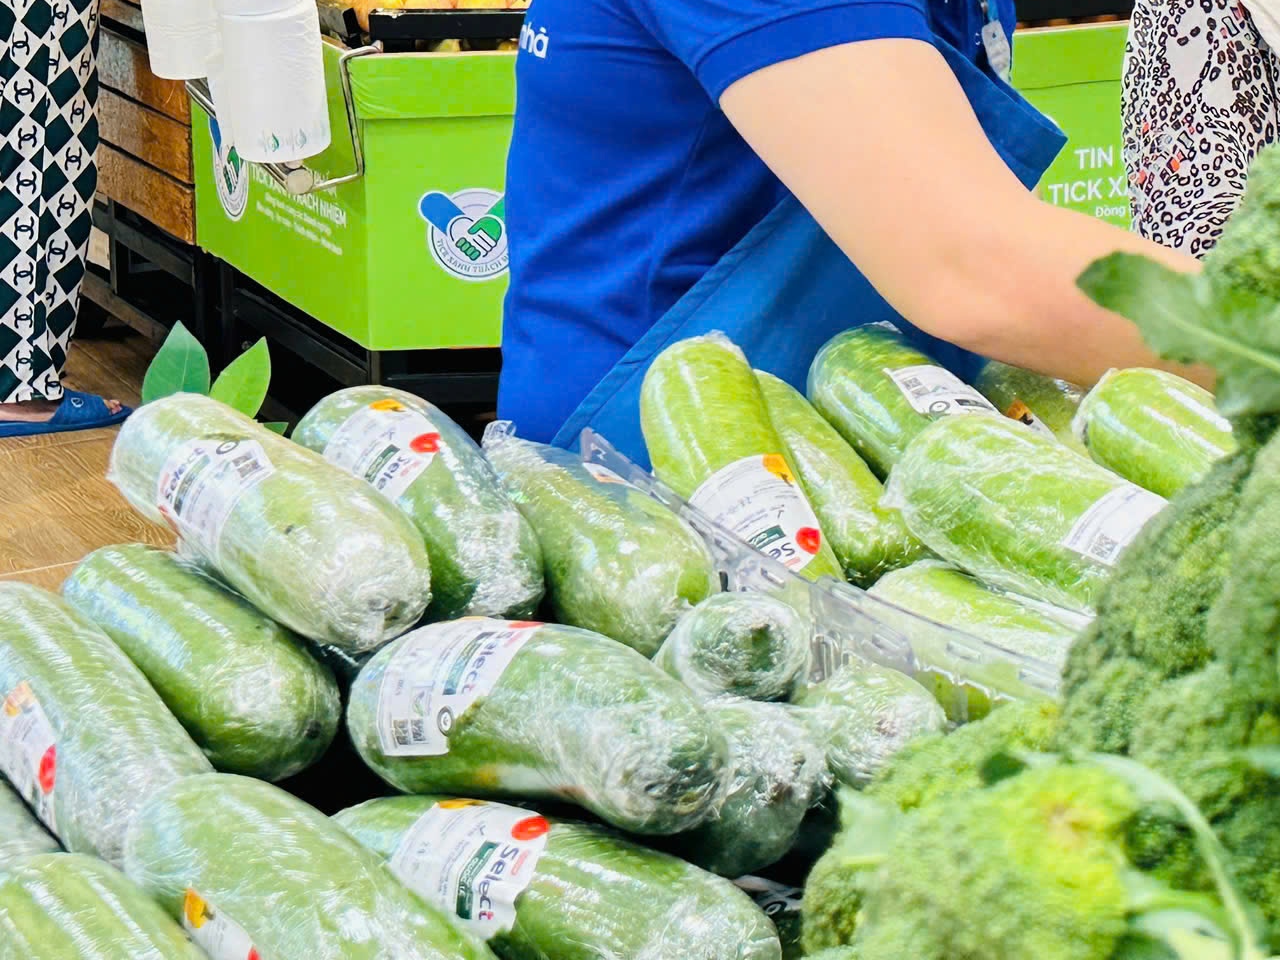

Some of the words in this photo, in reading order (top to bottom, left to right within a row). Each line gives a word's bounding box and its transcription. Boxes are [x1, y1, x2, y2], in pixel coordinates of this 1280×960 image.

[1074, 145, 1113, 170] TIN
[1047, 177, 1104, 205] TICK
[478, 844, 520, 921] Select
